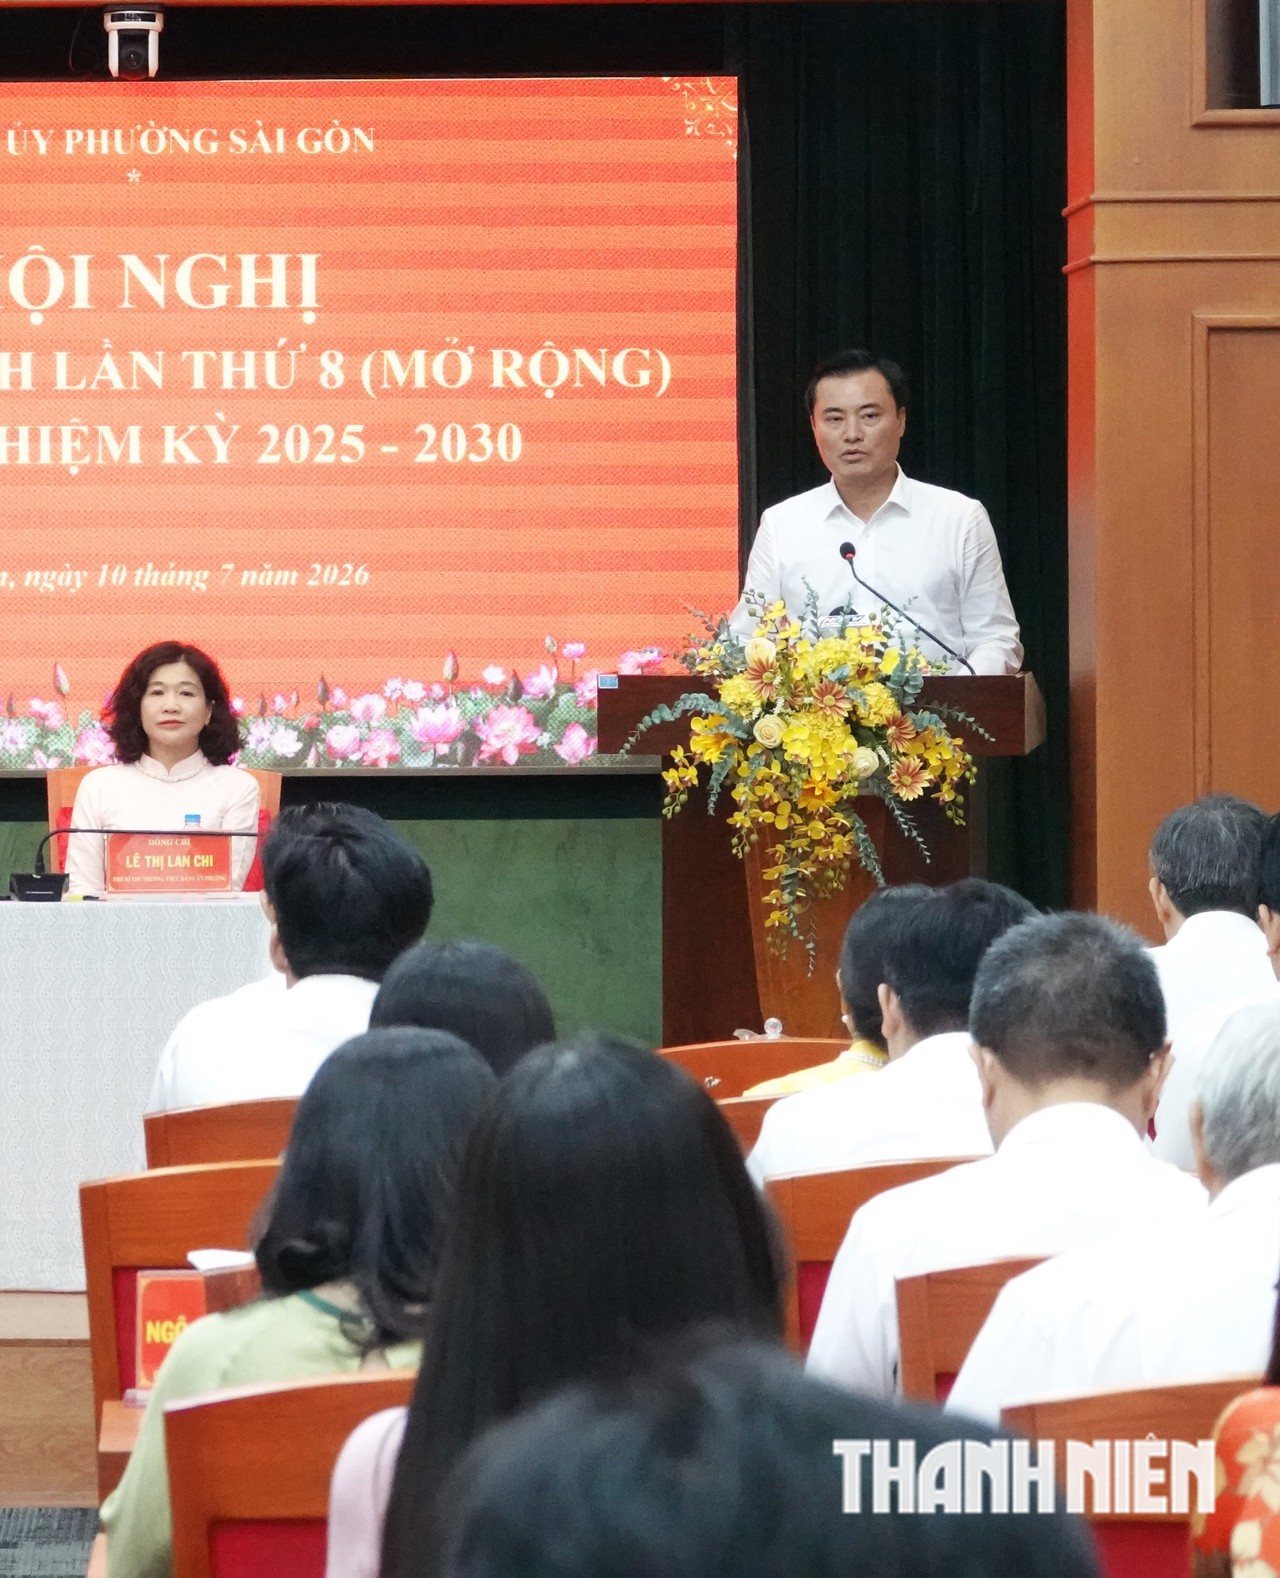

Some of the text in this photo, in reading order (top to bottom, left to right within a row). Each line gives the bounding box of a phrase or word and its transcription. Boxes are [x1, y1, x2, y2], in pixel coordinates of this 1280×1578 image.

[6, 120, 55, 156] ỦY
[65, 120, 220, 155] PHƯỜNG
[228, 119, 286, 154] SÀI
[297, 119, 375, 154] GÒN
[116, 252, 323, 326] NGHỊ
[53, 337, 165, 391] LẦN
[181, 337, 308, 390] THỨ
[319, 349, 346, 390] 8
[360, 336, 476, 399] (MỞ
[488, 340, 672, 399] RỘNG)
[160, 411, 243, 465] KỲ
[256, 423, 366, 464] 2025
[414, 422, 523, 463] 2030
[23, 562, 89, 594] ngày
[97, 563, 128, 588] 10
[133, 562, 210, 593] tháng
[220, 562, 236, 587] 7
[240, 562, 299, 587] năm
[306, 562, 370, 587] 2026
[125, 852, 214, 870] LÊ THỊ LAN CHI
